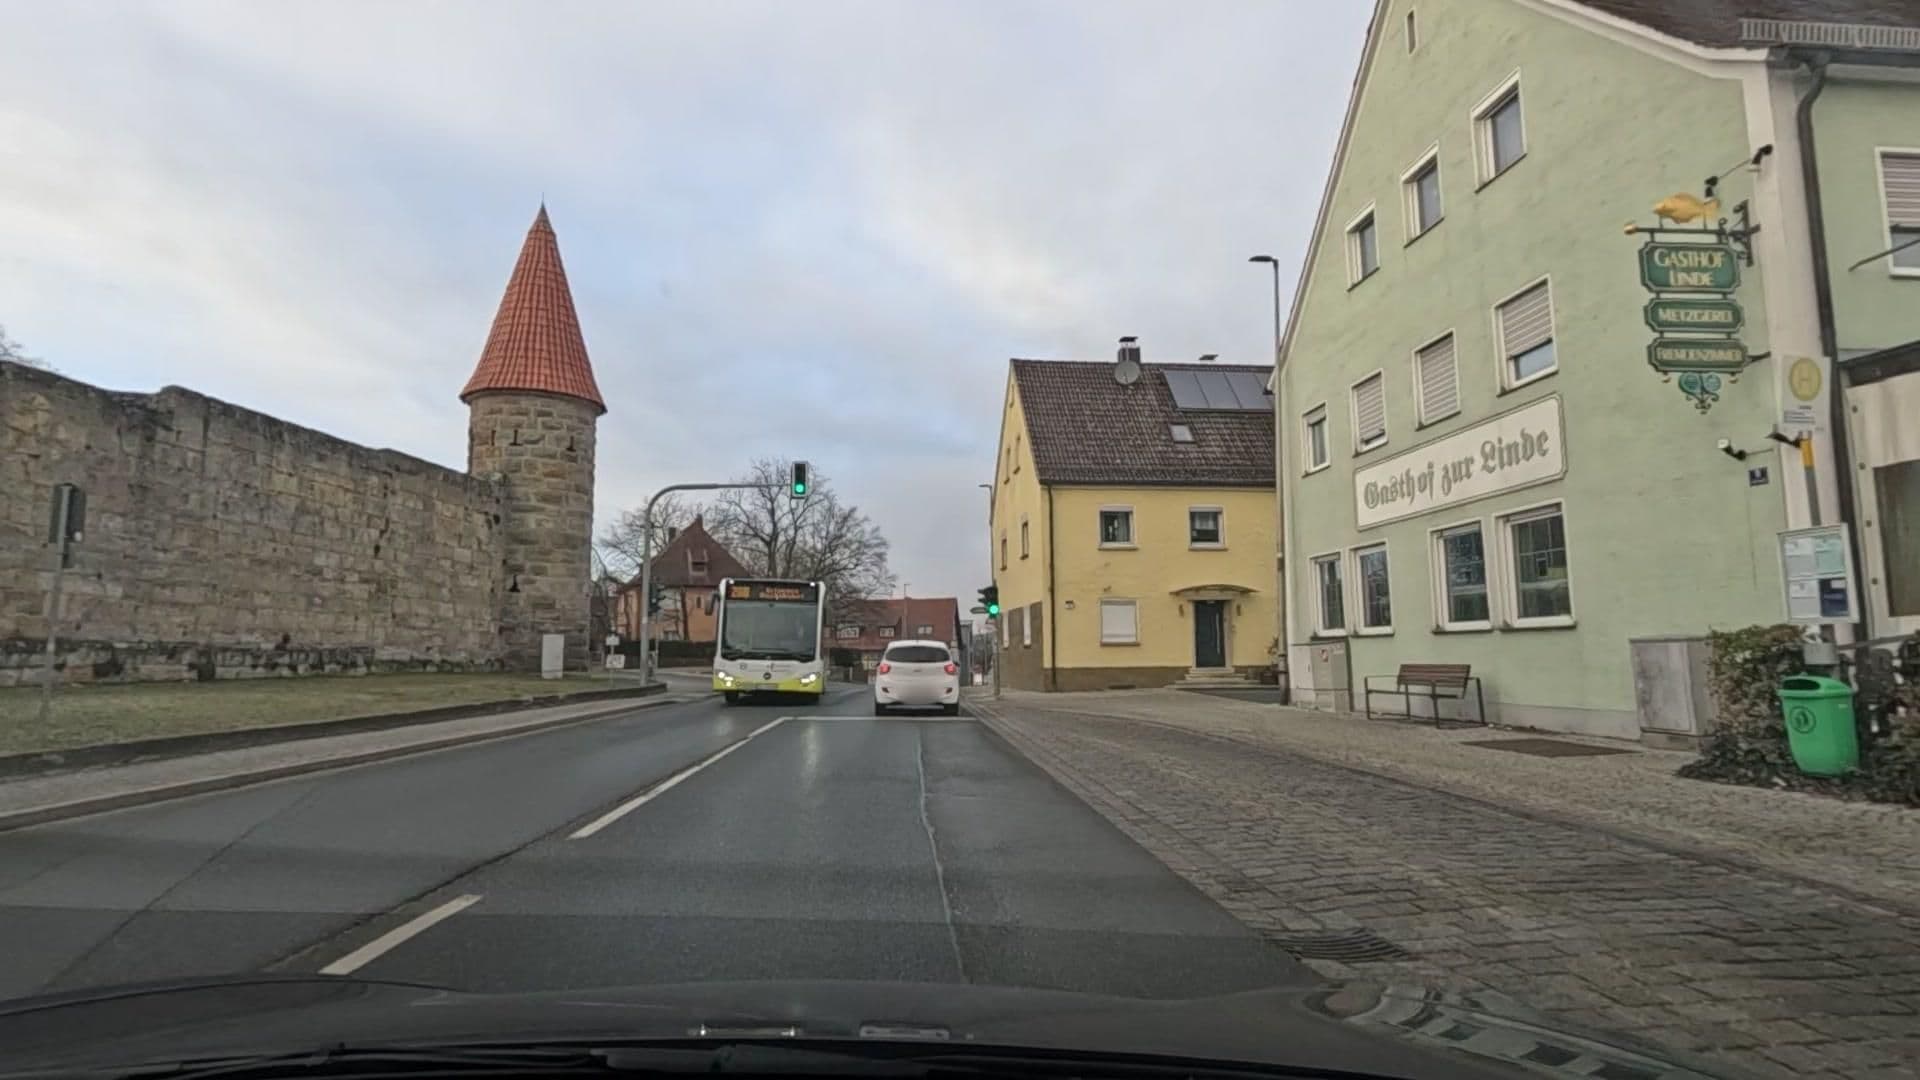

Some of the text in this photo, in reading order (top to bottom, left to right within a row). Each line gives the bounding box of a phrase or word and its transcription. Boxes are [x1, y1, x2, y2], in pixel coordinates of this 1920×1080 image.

[1654, 248, 1726, 269] GASTHOF
[1669, 269, 1714, 287] LINDE
[1658, 307, 1734, 322] METZGEREI
[1364, 428, 1550, 509] Gasthof zur Linde
